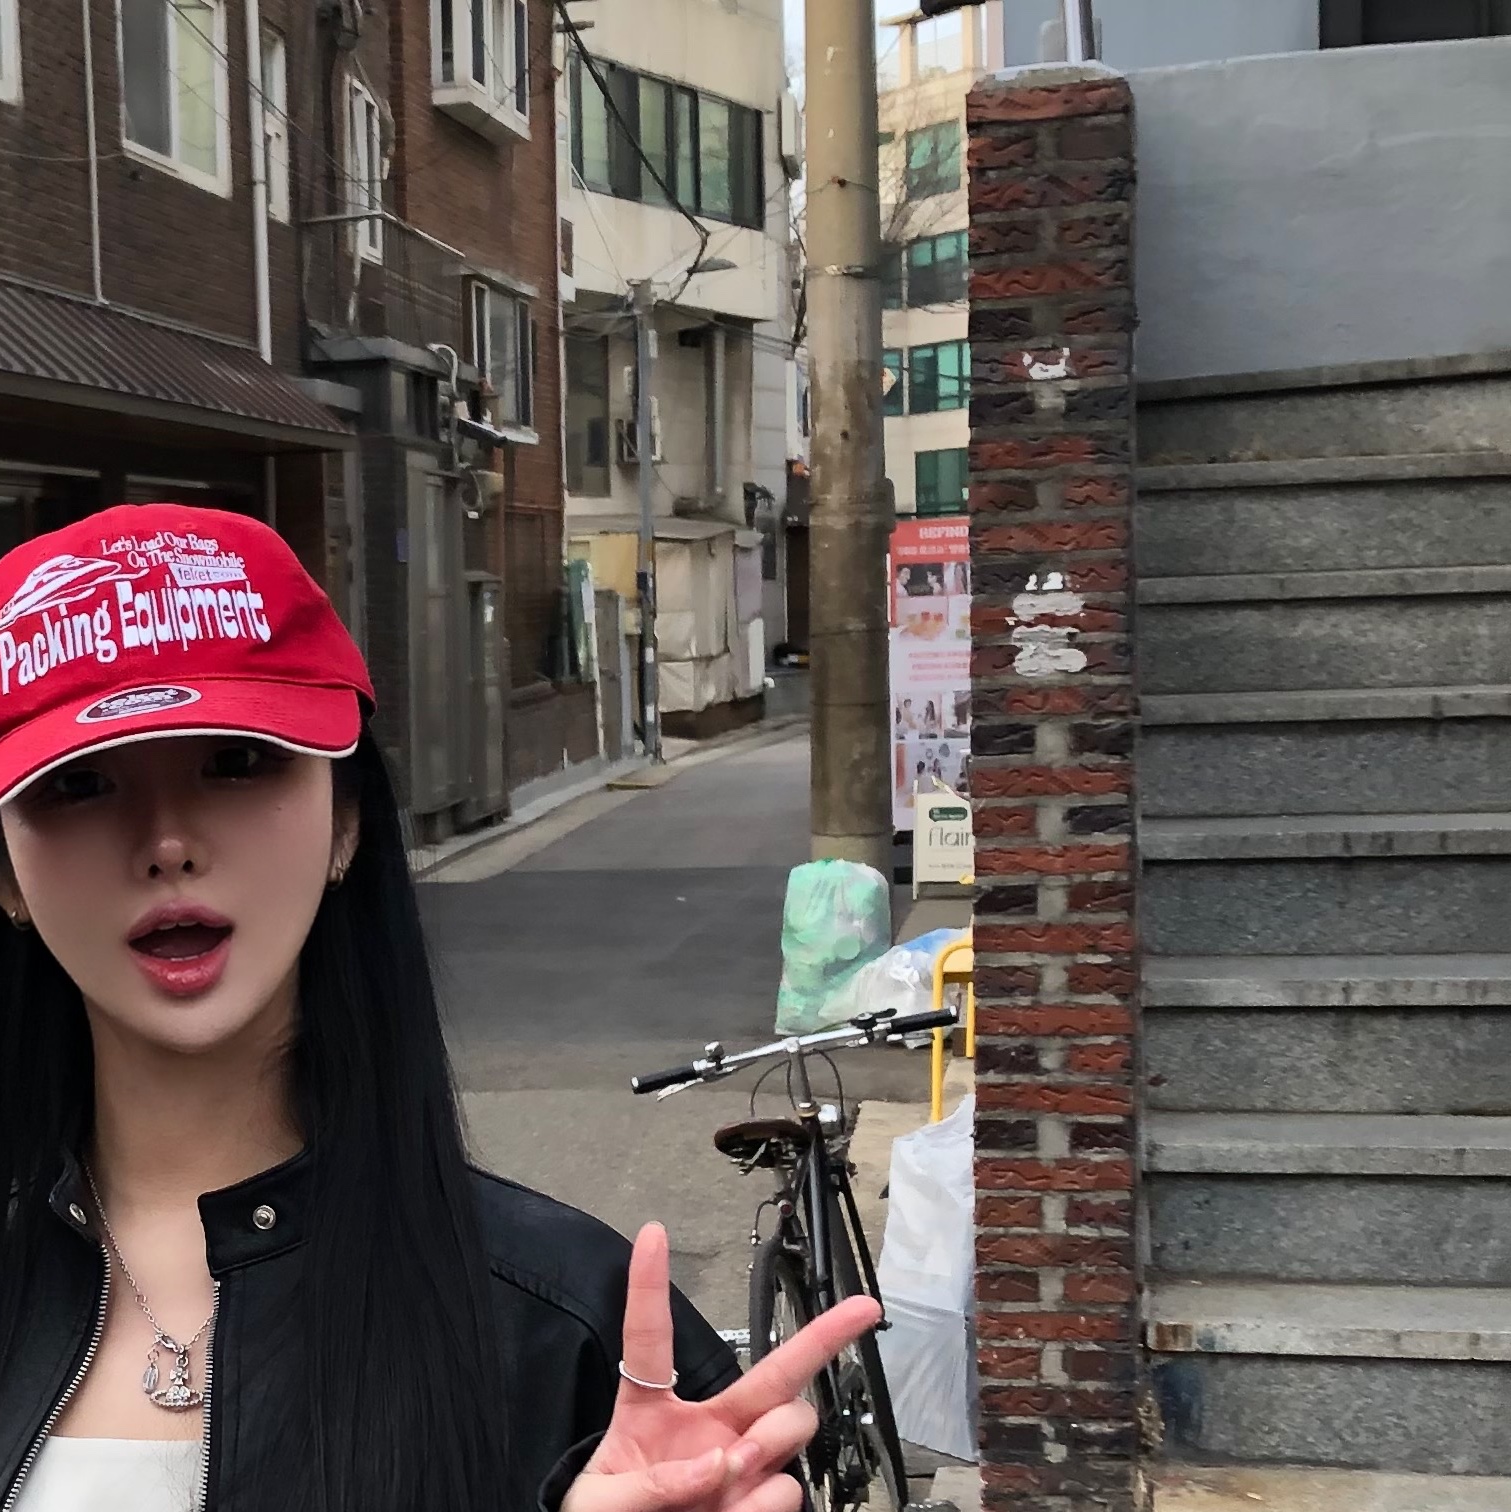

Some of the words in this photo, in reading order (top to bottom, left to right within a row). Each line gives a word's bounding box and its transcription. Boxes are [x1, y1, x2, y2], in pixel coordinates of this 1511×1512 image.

[101, 536, 132, 555] Let's
[132, 532, 165, 552] Load
[164, 532, 188, 549] Our
[186, 533, 219, 555] Bags
[127, 551, 147, 568] On
[146, 549, 174, 567] The
[174, 548, 245, 569] Snowmobile
[116, 574, 271, 655] Equipment
